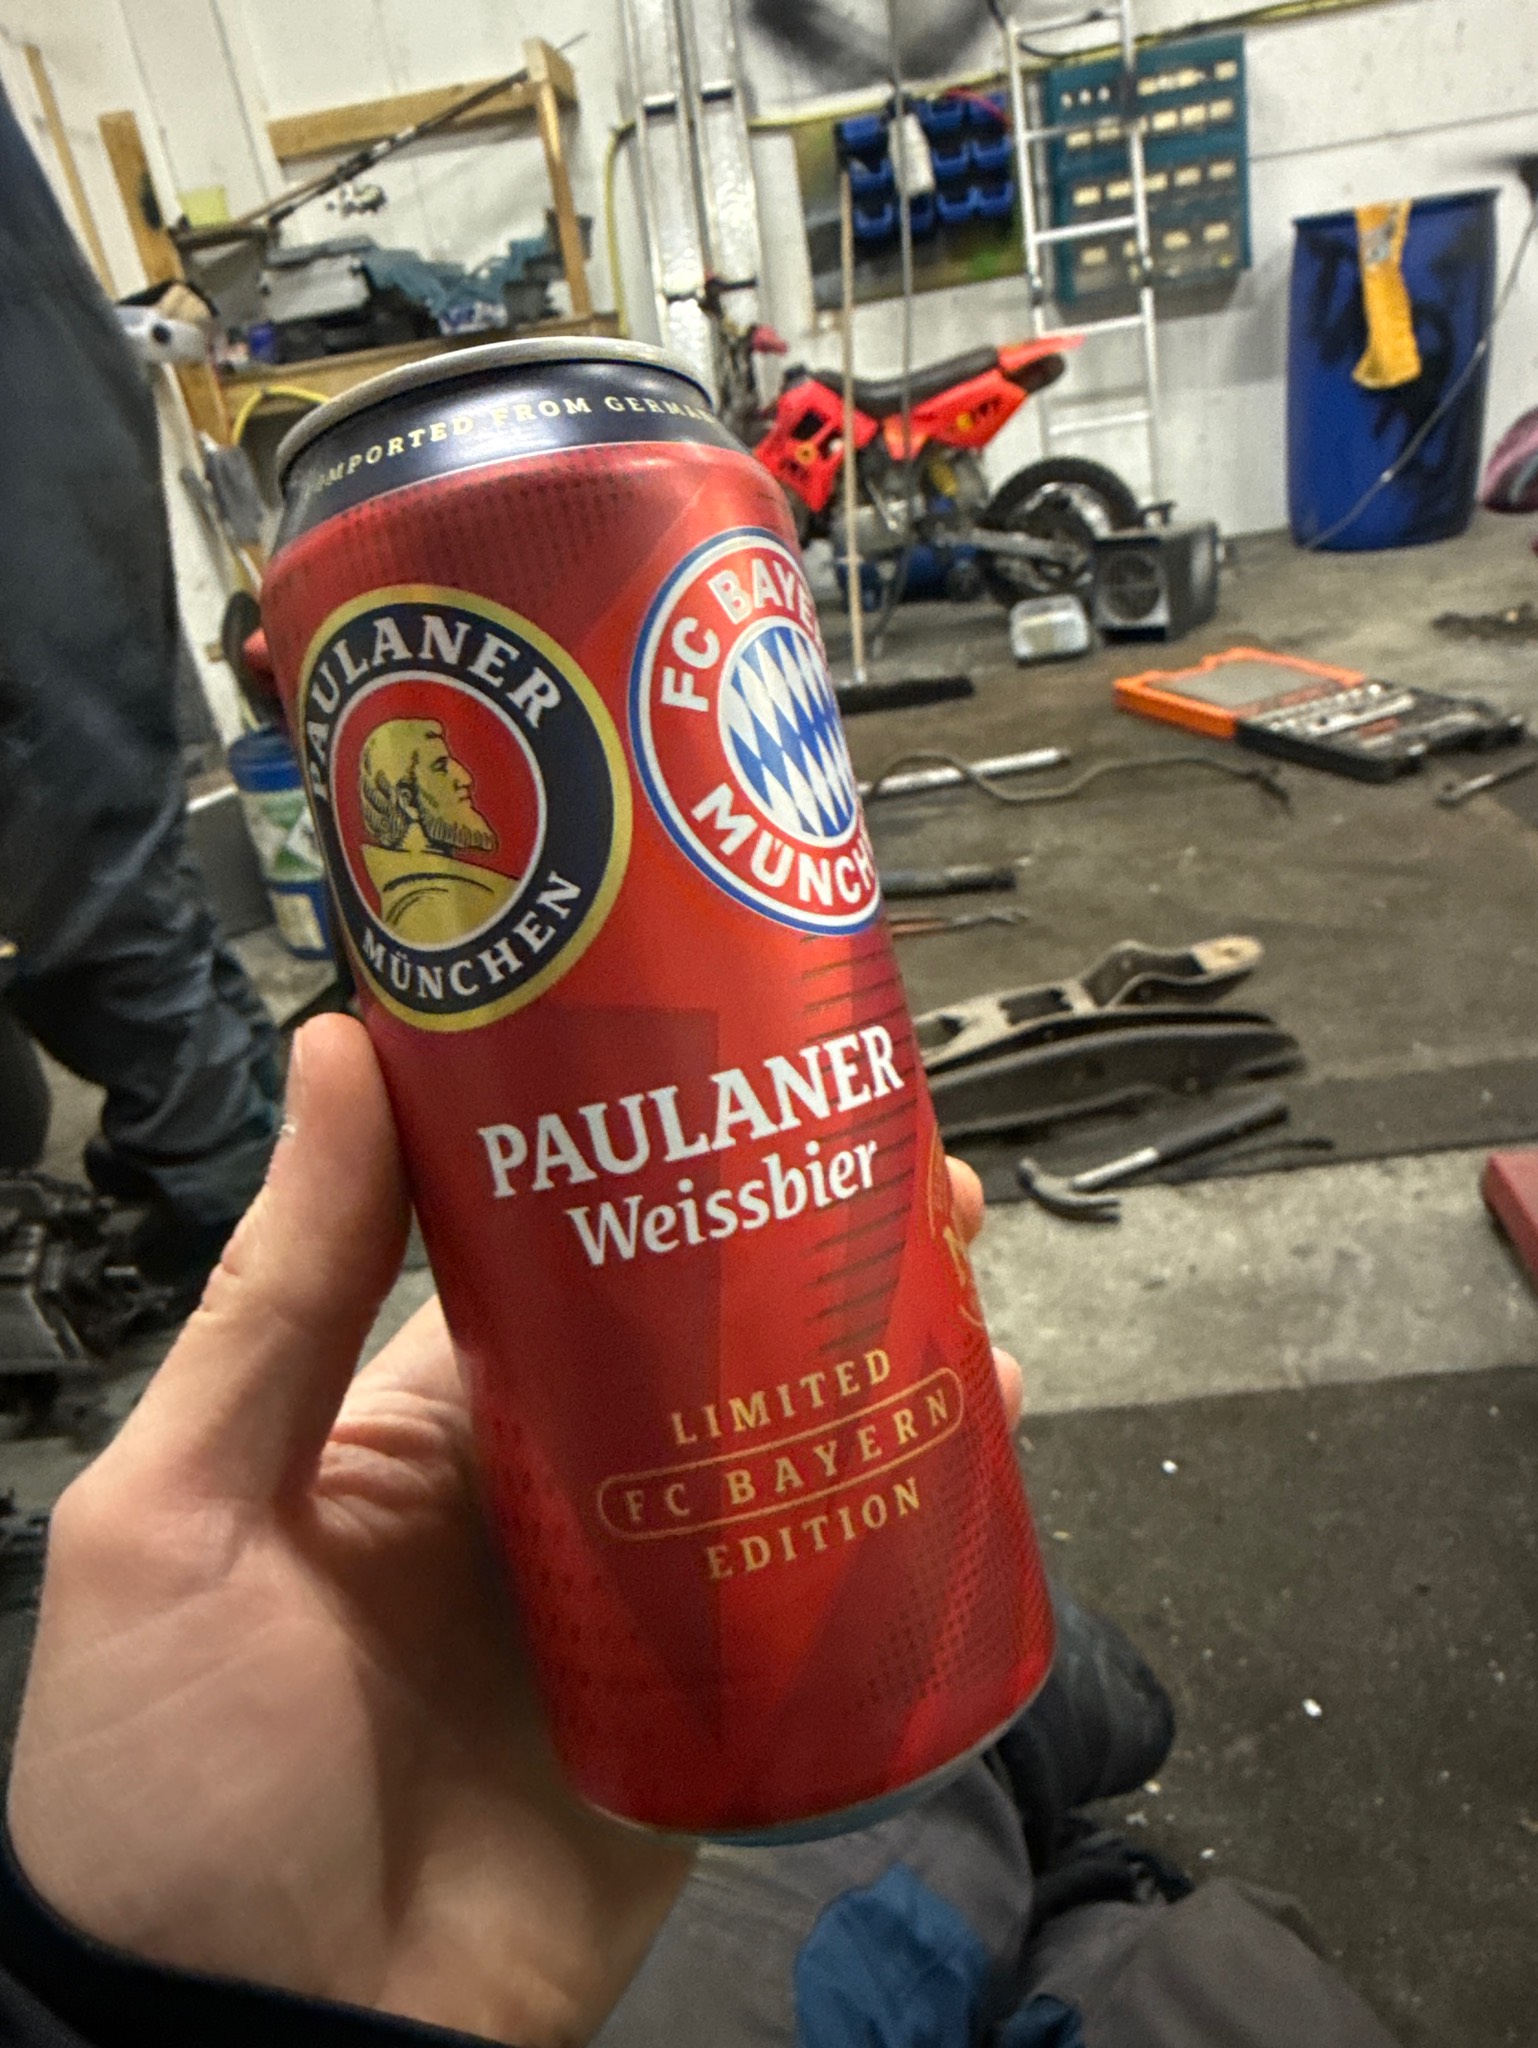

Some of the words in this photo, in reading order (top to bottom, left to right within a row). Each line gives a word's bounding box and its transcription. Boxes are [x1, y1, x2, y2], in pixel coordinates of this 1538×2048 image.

[492, 396, 593, 426] FROM
[661, 616, 720, 713] FC
[707, 557, 820, 642] BAYE
[307, 614, 562, 800] PAULANER
[691, 782, 876, 906] MÜNCH
[362, 871, 582, 1000] MÜNCHEN
[477, 1024, 905, 1198] PAULANER
[566, 1139, 878, 1267] Weissbier
[624, 1482, 691, 1523] FC
[725, 1387, 949, 1507] BAYERN
[670, 1348, 891, 1447] LIMITED
[704, 1476, 921, 1580] EDITION
